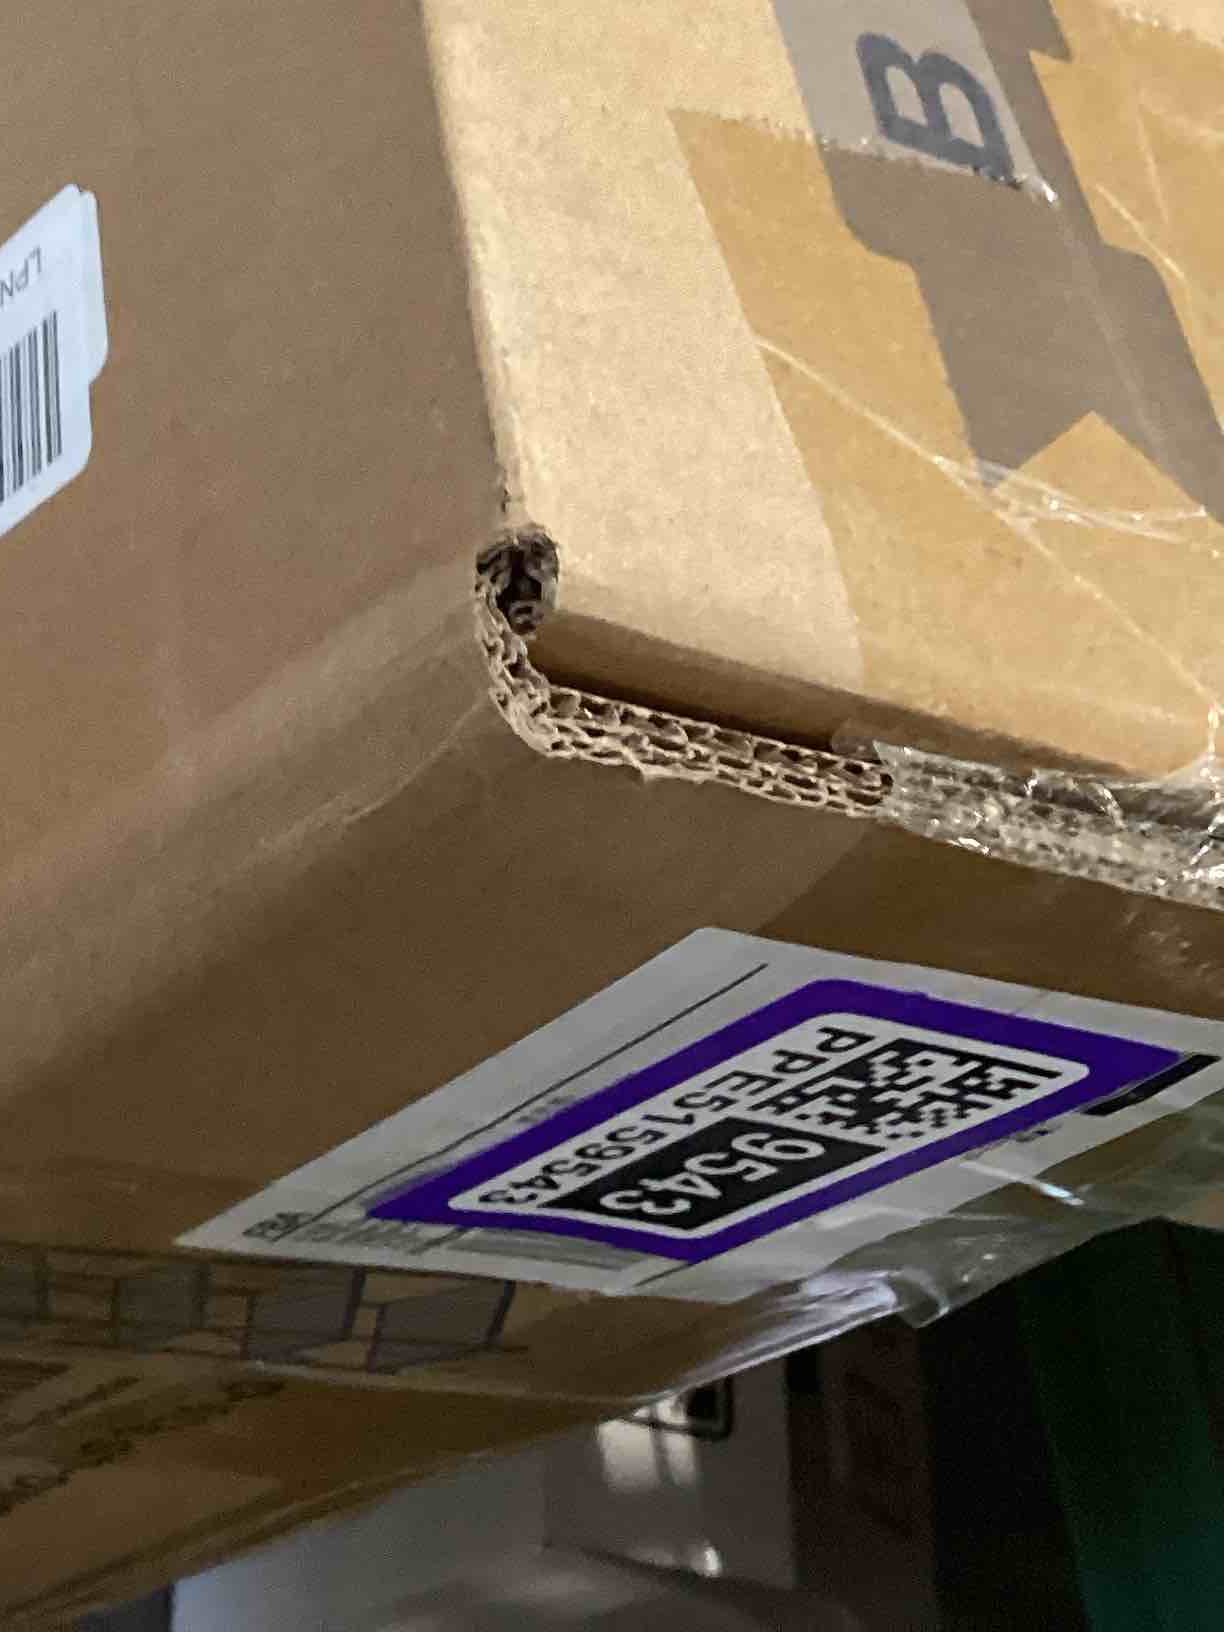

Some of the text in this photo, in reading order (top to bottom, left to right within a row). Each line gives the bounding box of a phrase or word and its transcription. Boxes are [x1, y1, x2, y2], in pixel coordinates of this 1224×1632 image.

[855, 31, 1022, 191] B
[479, 1026, 876, 1206] PPE5159543
[599, 1131, 826, 1216] 9543
